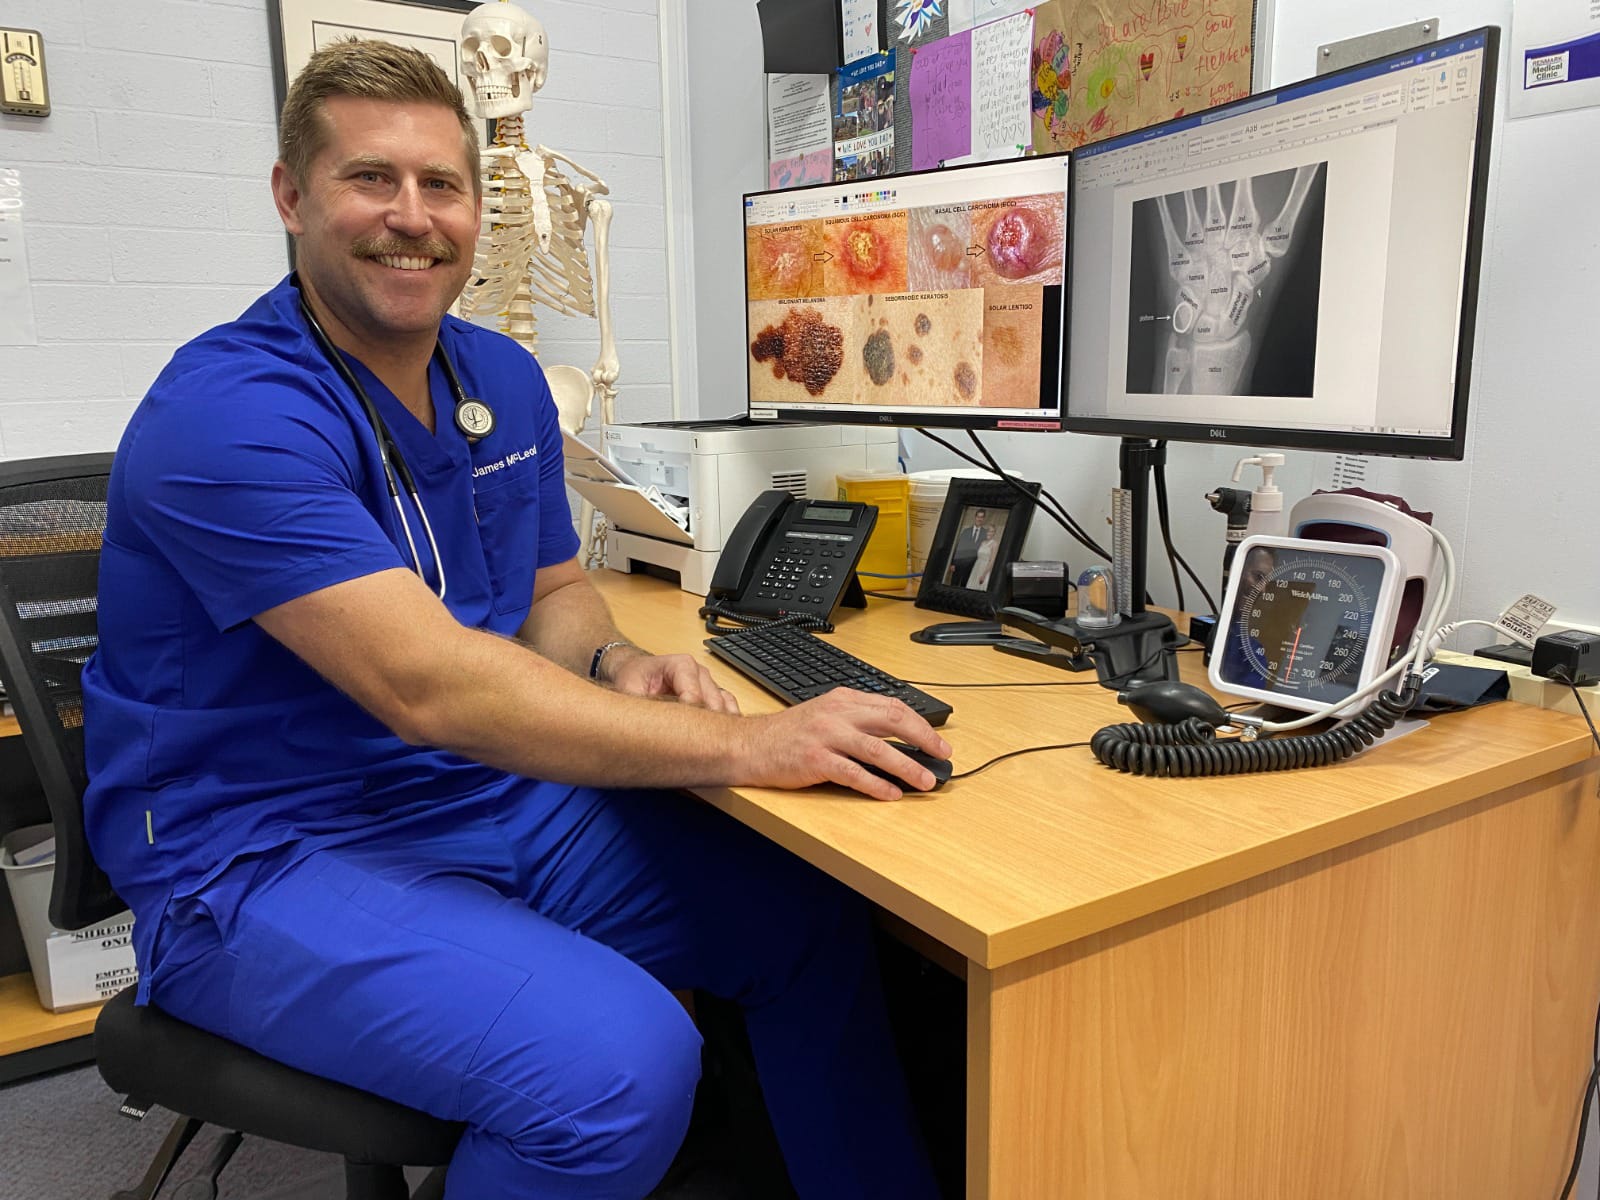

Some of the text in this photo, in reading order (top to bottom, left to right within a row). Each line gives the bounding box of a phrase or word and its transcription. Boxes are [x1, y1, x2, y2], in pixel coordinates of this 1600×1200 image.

[1532, 56, 1562, 66] RENMARK
[1532, 62, 1563, 74] Medical
[1536, 71, 1558, 80] Clinic
[842, 144, 852, 153] WE
[853, 139, 867, 152] LOVE
[868, 137, 878, 146] YOU
[967, 202, 1000, 211] CARCINOMA
[850, 215, 862, 223] CELL
[863, 212, 891, 222] CARCINOMA
[920, 292, 949, 300] KERATOSIS
[879, 415, 893, 423] DELL
[1210, 429, 1226, 438] DELL
[472, 460, 505, 478] James
[1293, 571, 1306, 581] 140
[1312, 570, 1325, 580] 160
[1276, 579, 1289, 589] 120
[1328, 579, 1342, 589] 180
[1262, 592, 1275, 602] 100
[1338, 593, 1353, 603] 200
[1252, 609, 1261, 618] 80
[1344, 609, 1359, 620] 220
[1250, 629, 1260, 638] 60
[1500, 619, 1533, 639] CAUTION
[1343, 629, 1358, 640] 240
[1256, 647, 1265, 656] 40
[1333, 647, 1349, 657] 260
[1268, 660, 1278, 670] 20
[1320, 660, 1334, 671] 280
[1301, 668, 1316, 679] 300
